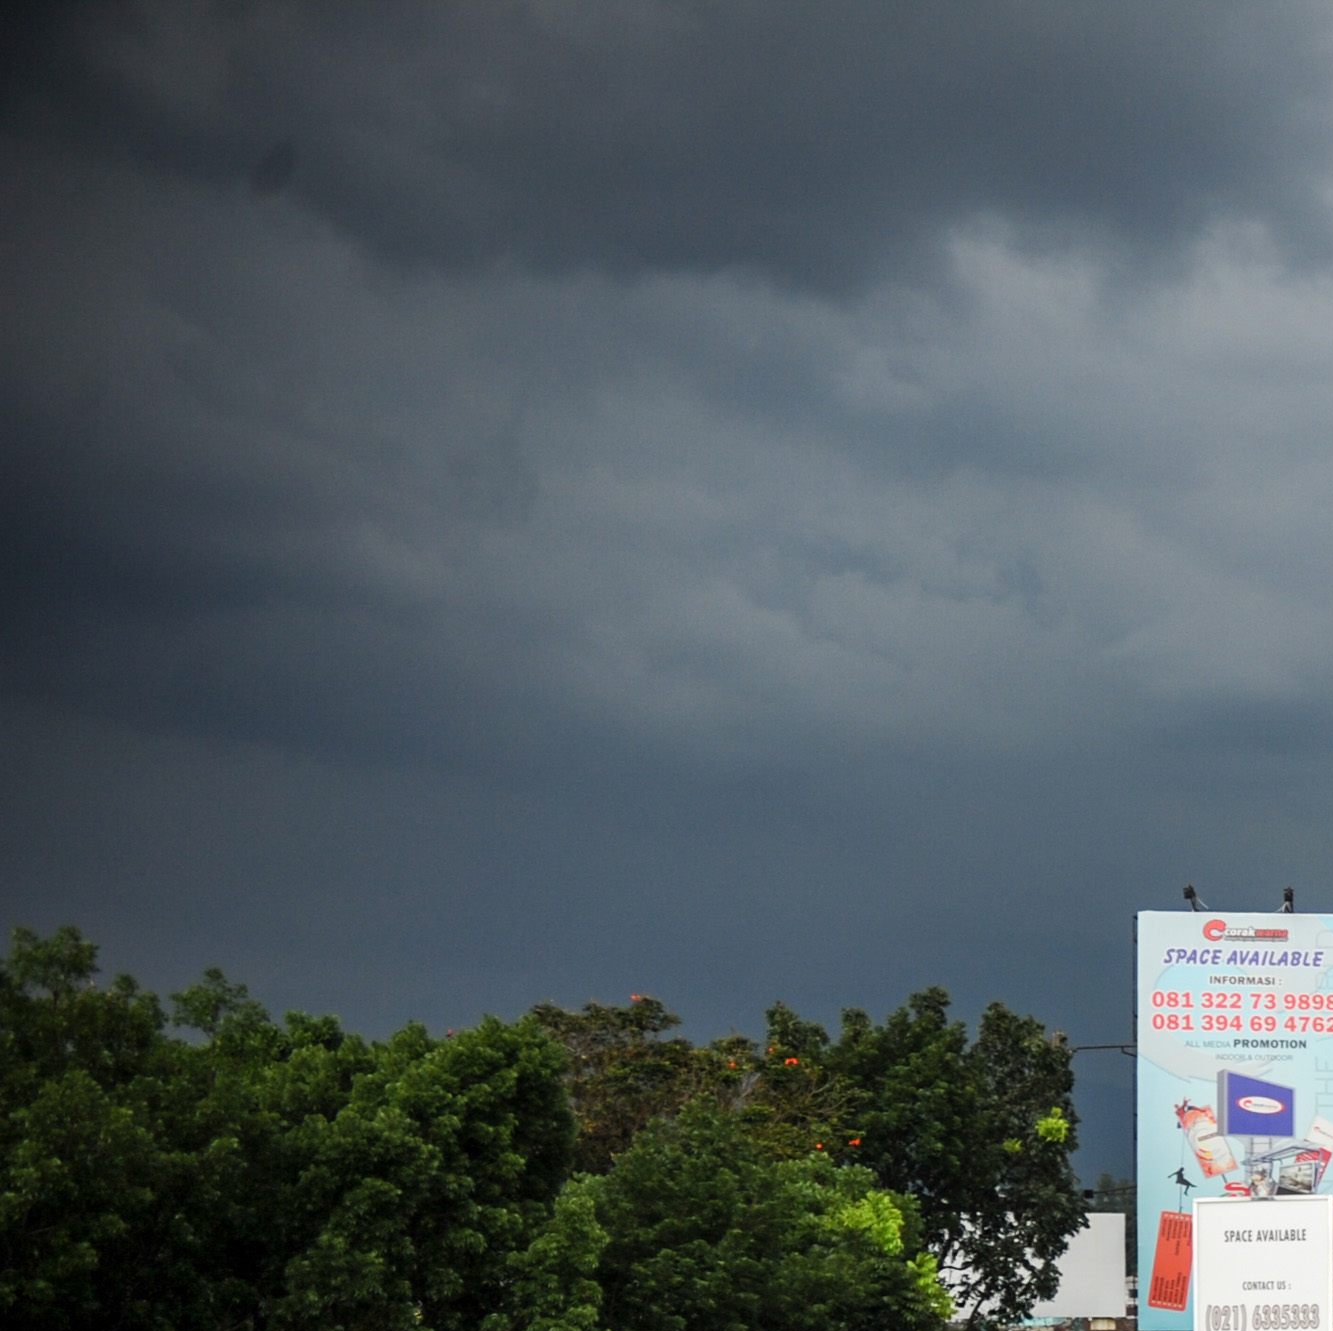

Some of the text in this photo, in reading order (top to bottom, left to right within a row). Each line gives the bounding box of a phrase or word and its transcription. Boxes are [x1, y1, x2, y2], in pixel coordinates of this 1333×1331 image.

[1163, 949, 1324, 967] SPACE AVAILABLE
[1209, 976, 1276, 985] INFORMASI
[1152, 991, 1194, 1008] 081
[1201, 992, 1242, 1009] 322
[1250, 993, 1277, 1010] 73
[1152, 1014, 1194, 1030] 081
[1201, 1015, 1243, 1031] 394
[1250, 1016, 1277, 1032] 69
[1184, 1039, 1307, 1049] ALL MEDIA PROMOTION
[1224, 1229, 1307, 1242] SPACE AVAILABLE
[1242, 1281, 1275, 1291] CONTACT
[1276, 1281, 1287, 1290] US
[1252, 1303, 1320, 1331] 6335333
